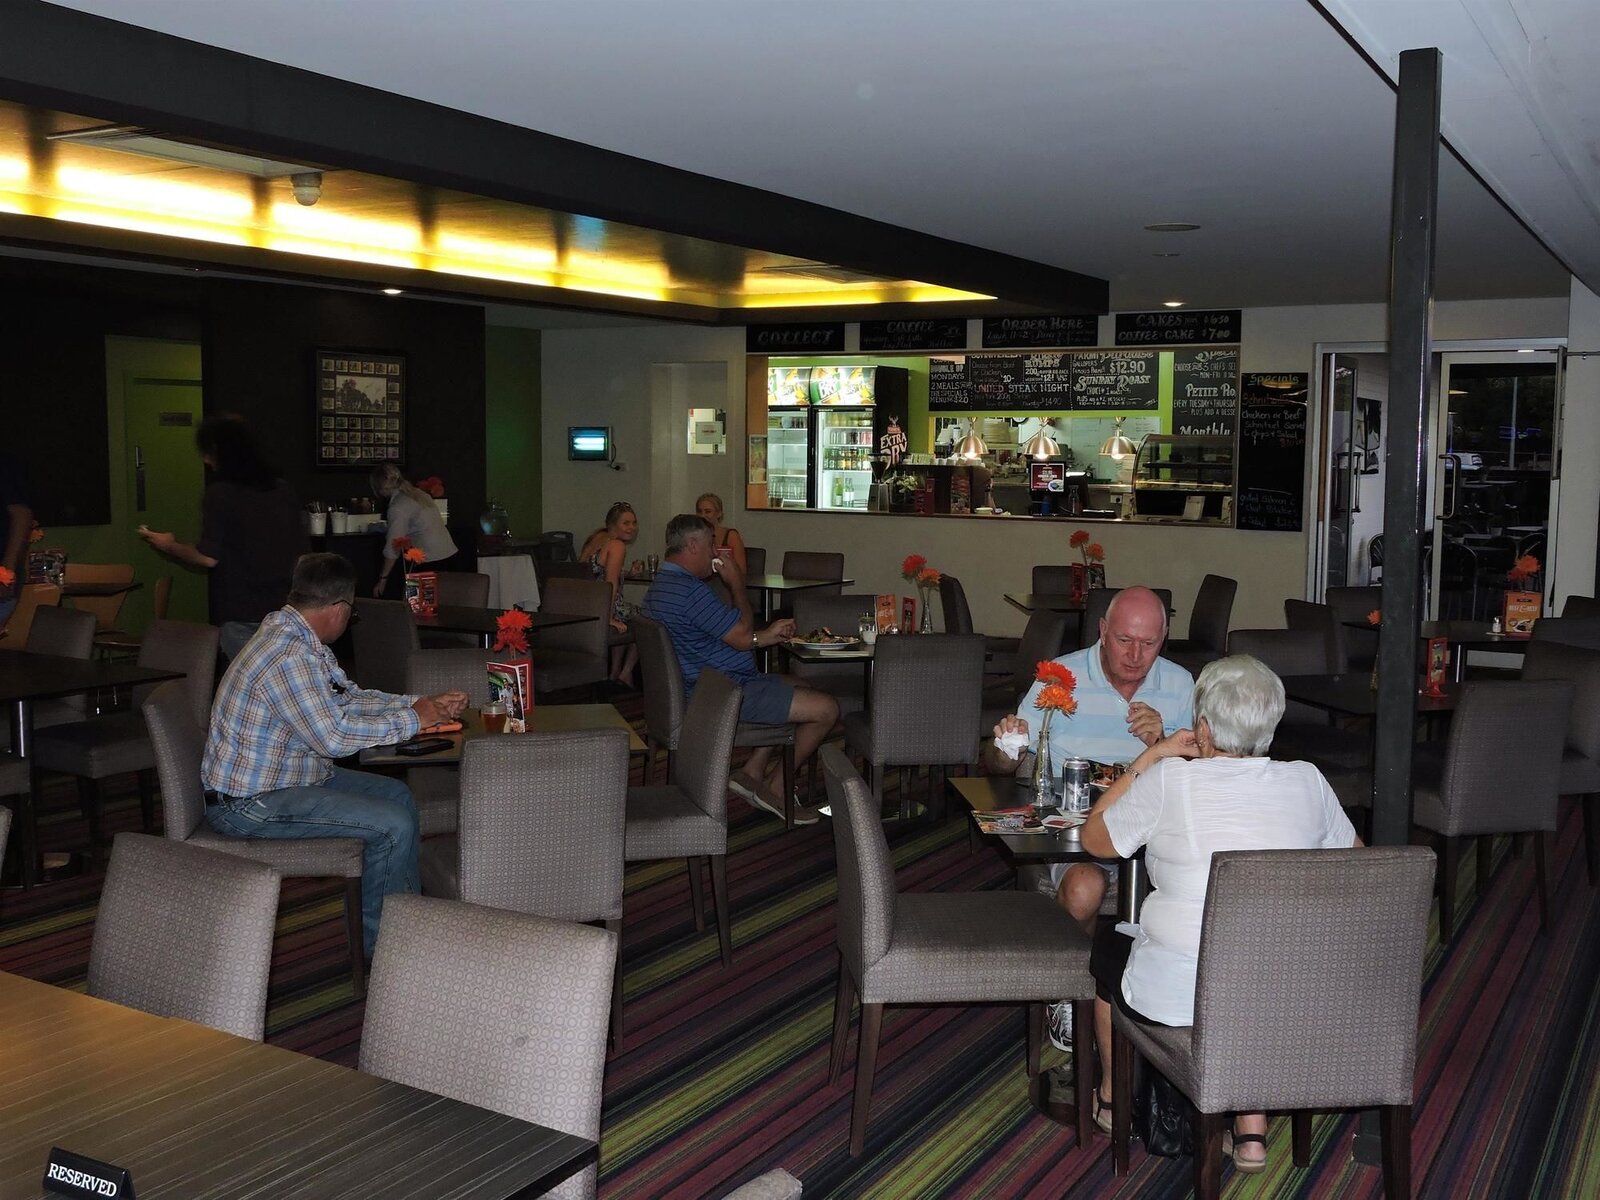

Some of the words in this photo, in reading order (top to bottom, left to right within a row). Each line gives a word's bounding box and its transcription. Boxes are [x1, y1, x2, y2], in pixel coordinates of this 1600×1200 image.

[887, 320, 936, 334] COFFEE
[1002, 318, 1048, 331] ORDER
[1050, 316, 1085, 329] HERE
[757, 329, 836, 345] COLLECT
[1164, 329, 1196, 339] CAKE
[1110, 361, 1145, 374] $12.90
[931, 382, 936, 390] 2
[1073, 376, 1117, 392] SUNDAY
[1117, 375, 1151, 391] ROAST
[1250, 373, 1300, 387] Specials
[974, 384, 1004, 393] UNITED
[1008, 384, 1037, 393] STEAK
[1040, 383, 1070, 393] NIGHT
[1185, 383, 1219, 397] PETITE
[880, 432, 907, 450] EXTRA
[47, 1162, 118, 1197] RESERVED
